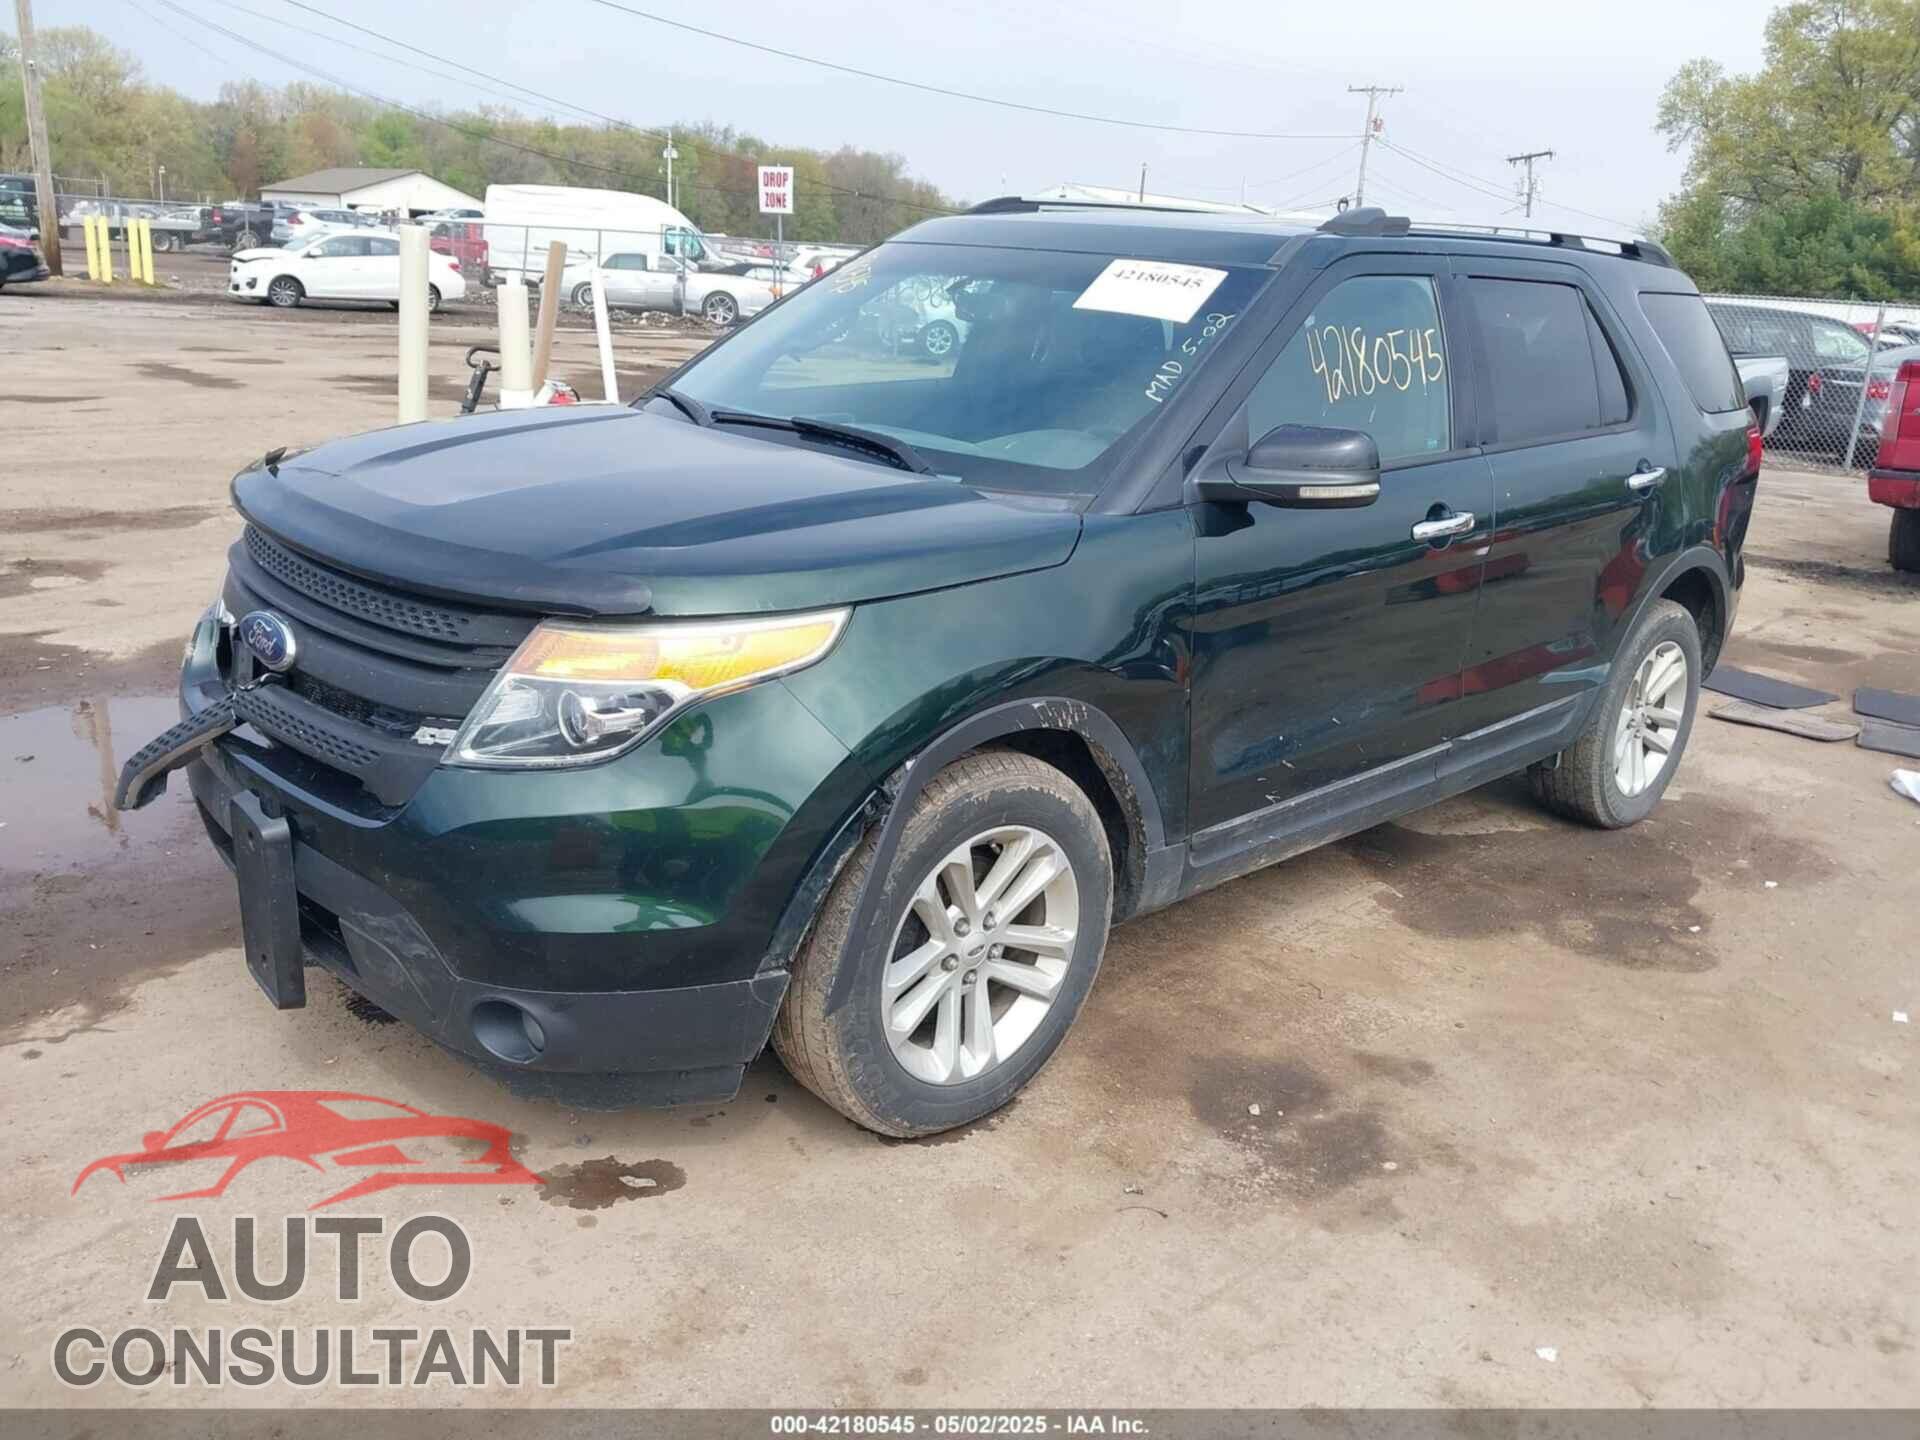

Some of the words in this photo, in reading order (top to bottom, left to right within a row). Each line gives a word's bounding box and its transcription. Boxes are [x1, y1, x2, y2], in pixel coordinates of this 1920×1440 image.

[763, 172, 788, 187] DROP
[765, 192, 787, 208] ZONE
[1145, 360, 1183, 403] MAD
[1306, 326, 1444, 404] 42180545
[248, 618, 278, 655] Ford
